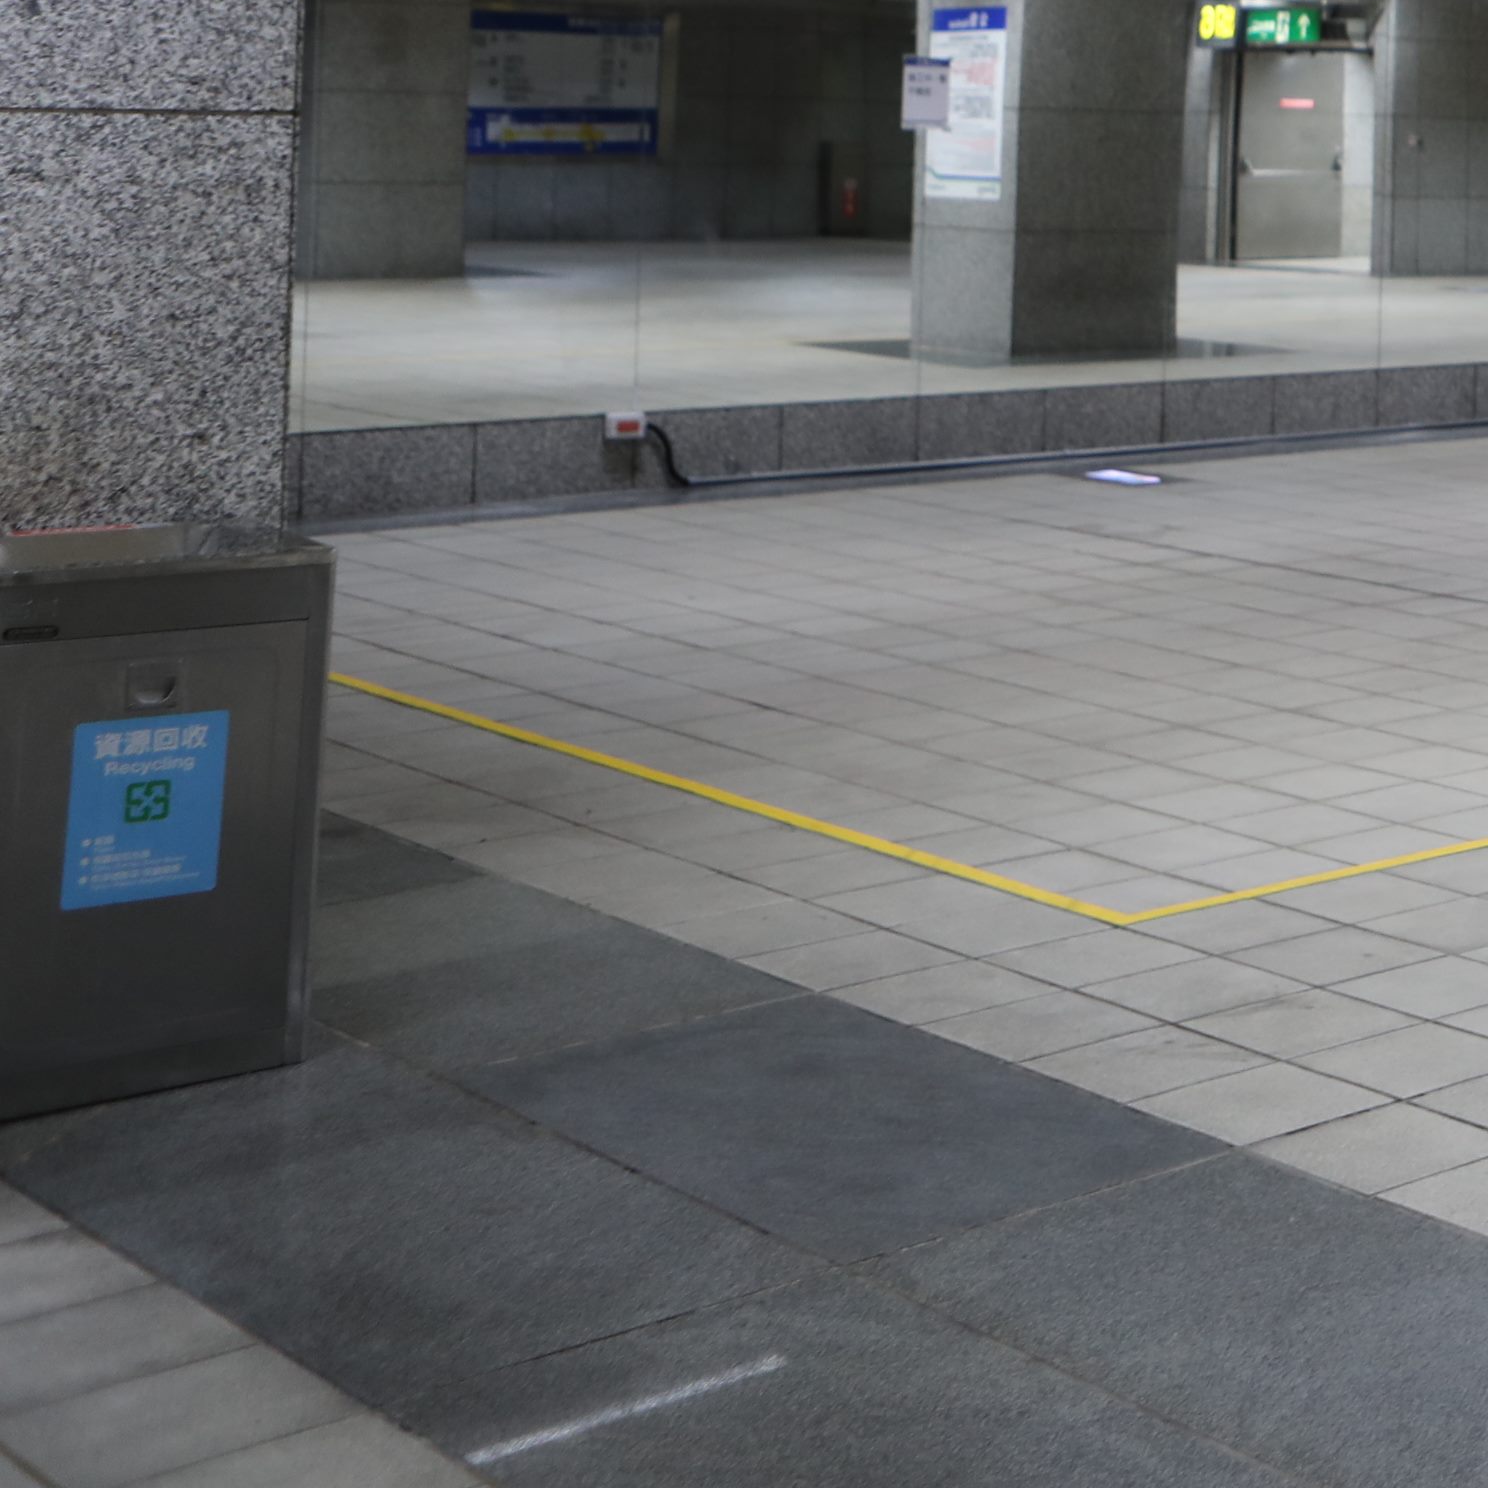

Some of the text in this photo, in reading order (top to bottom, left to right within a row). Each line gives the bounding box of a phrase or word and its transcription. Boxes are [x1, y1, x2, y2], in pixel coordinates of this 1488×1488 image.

[94, 723, 210, 760] 資源回收
[103, 756, 196, 776] Recycling
